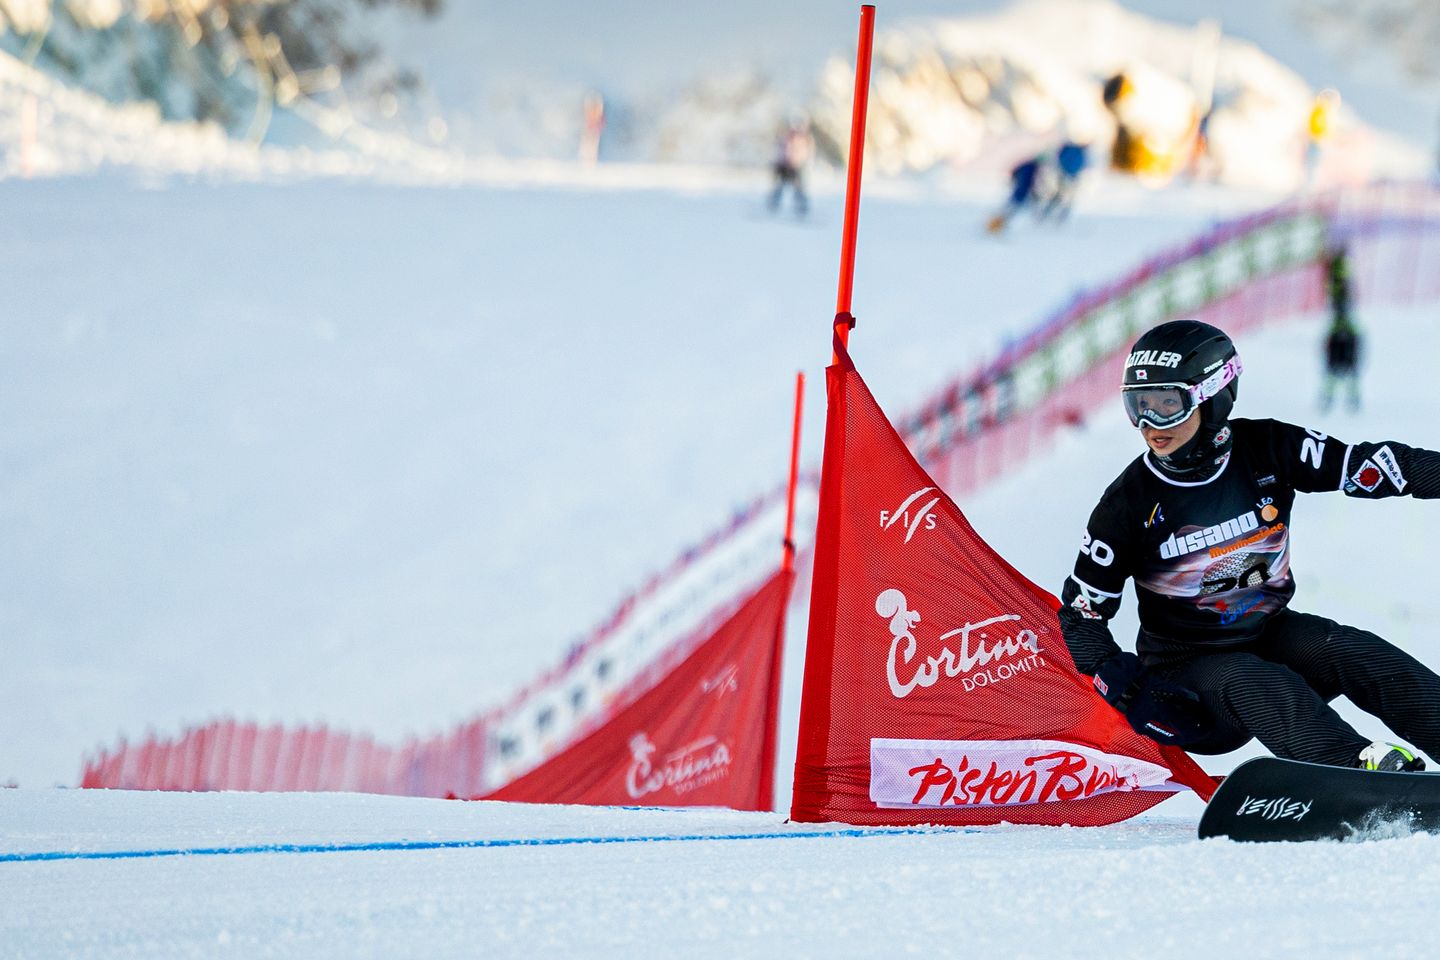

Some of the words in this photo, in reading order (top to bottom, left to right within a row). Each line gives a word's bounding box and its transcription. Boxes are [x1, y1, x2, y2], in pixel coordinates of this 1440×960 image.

[1256, 496, 1274, 509] LED
[1159, 510, 1259, 560] disano
[887, 613, 1045, 698] Cortina
[962, 653, 1046, 692] DOLOMITI
[626, 735, 731, 799] Cortina
